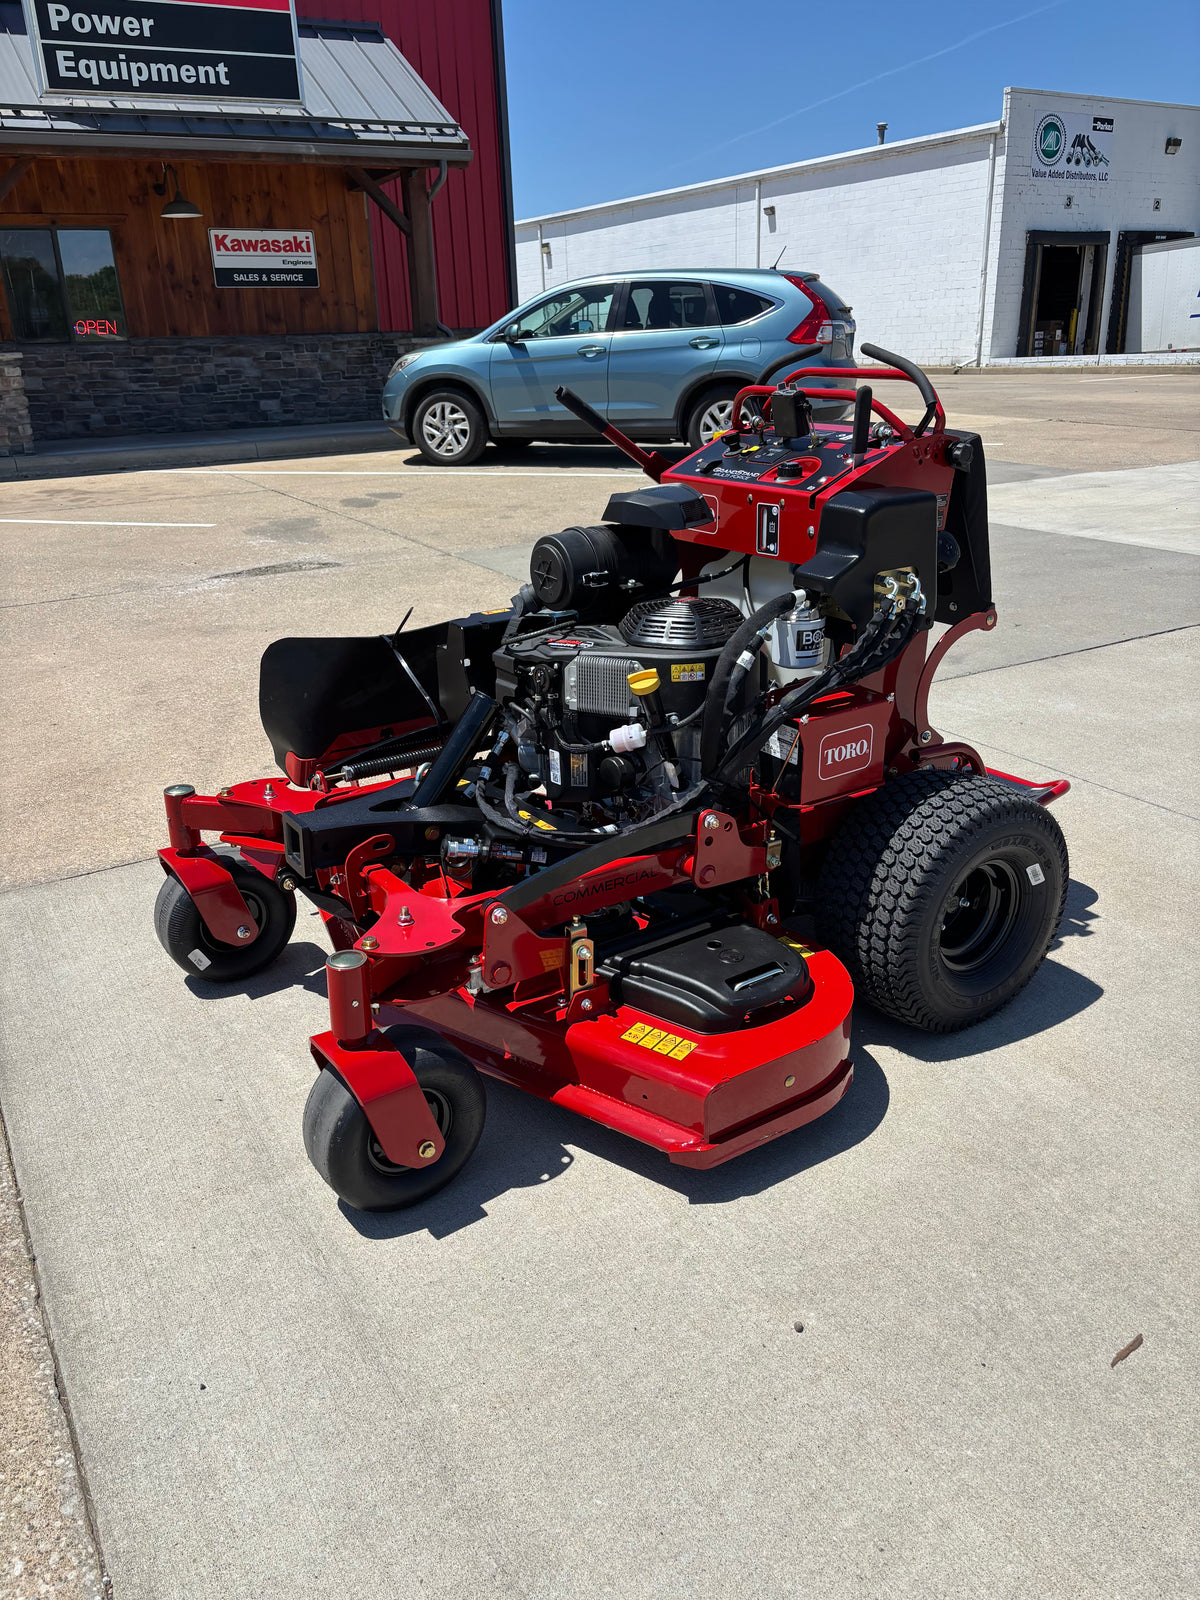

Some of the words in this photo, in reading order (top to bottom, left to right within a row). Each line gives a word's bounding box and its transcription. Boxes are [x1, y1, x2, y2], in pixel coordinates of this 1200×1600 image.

[46, 2, 155, 38] Power
[55, 49, 231, 88] Equipment
[1031, 168, 1047, 178] Value
[1047, 169, 1065, 180] Added
[1098, 172, 1109, 182] LLC
[213, 233, 312, 253] Kawasaki
[282, 258, 313, 266] Engines
[233, 273, 260, 282] SALES
[261, 273, 268, 282] &
[270, 273, 304, 282] SERVICE
[75, 319, 118, 336] OPEN
[823, 739, 868, 766] TORO
[552, 867, 660, 907] COMMERCIAL
